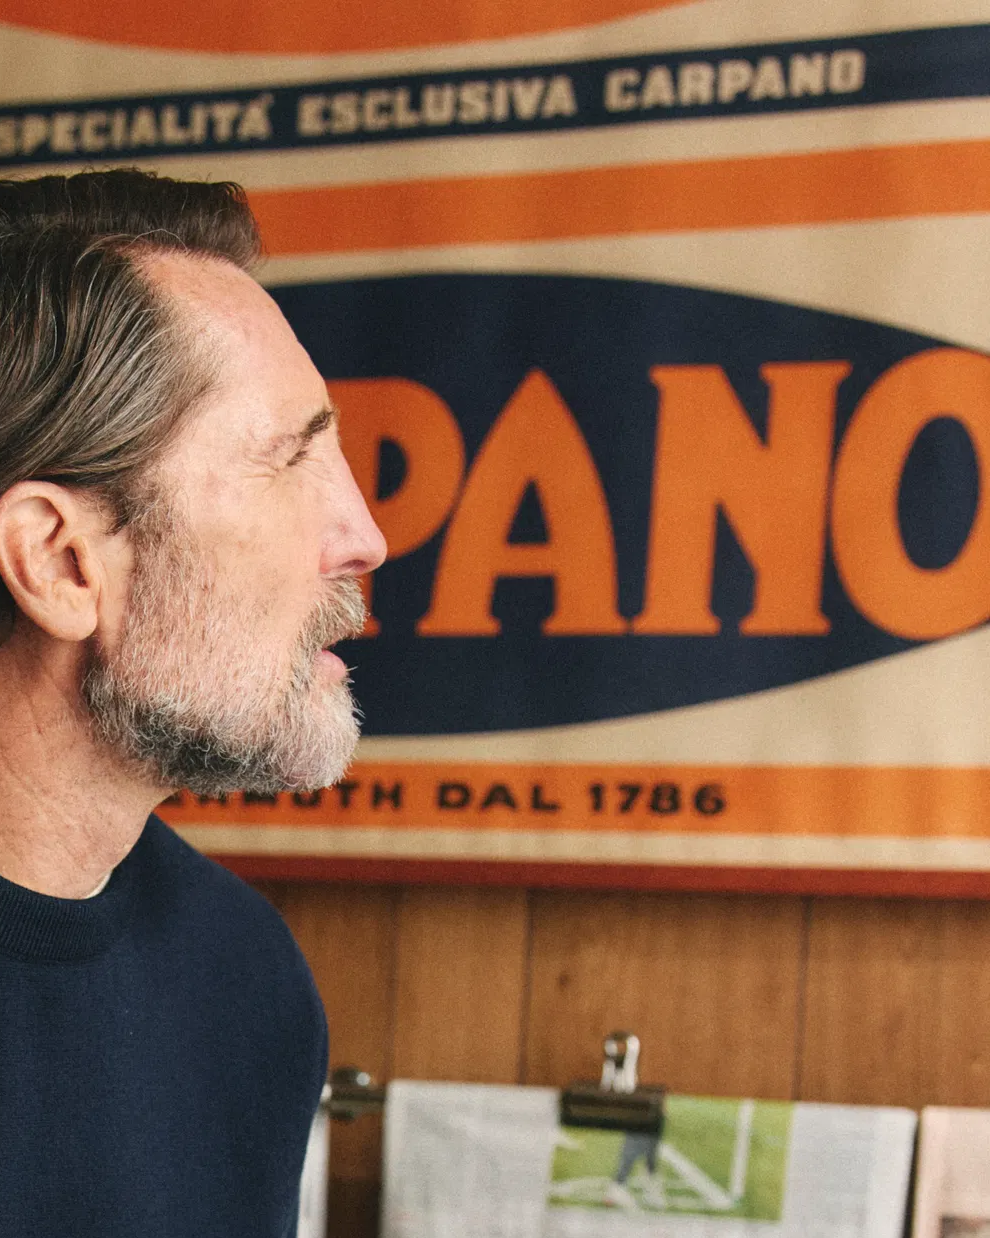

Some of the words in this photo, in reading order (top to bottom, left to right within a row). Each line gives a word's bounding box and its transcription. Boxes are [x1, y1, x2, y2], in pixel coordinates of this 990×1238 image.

[297, 74, 577, 137] ESCLUSIVA
[603, 48, 866, 113] CARPANO
[436, 781, 559, 812] DAL
[589, 782, 727, 816] 1786
